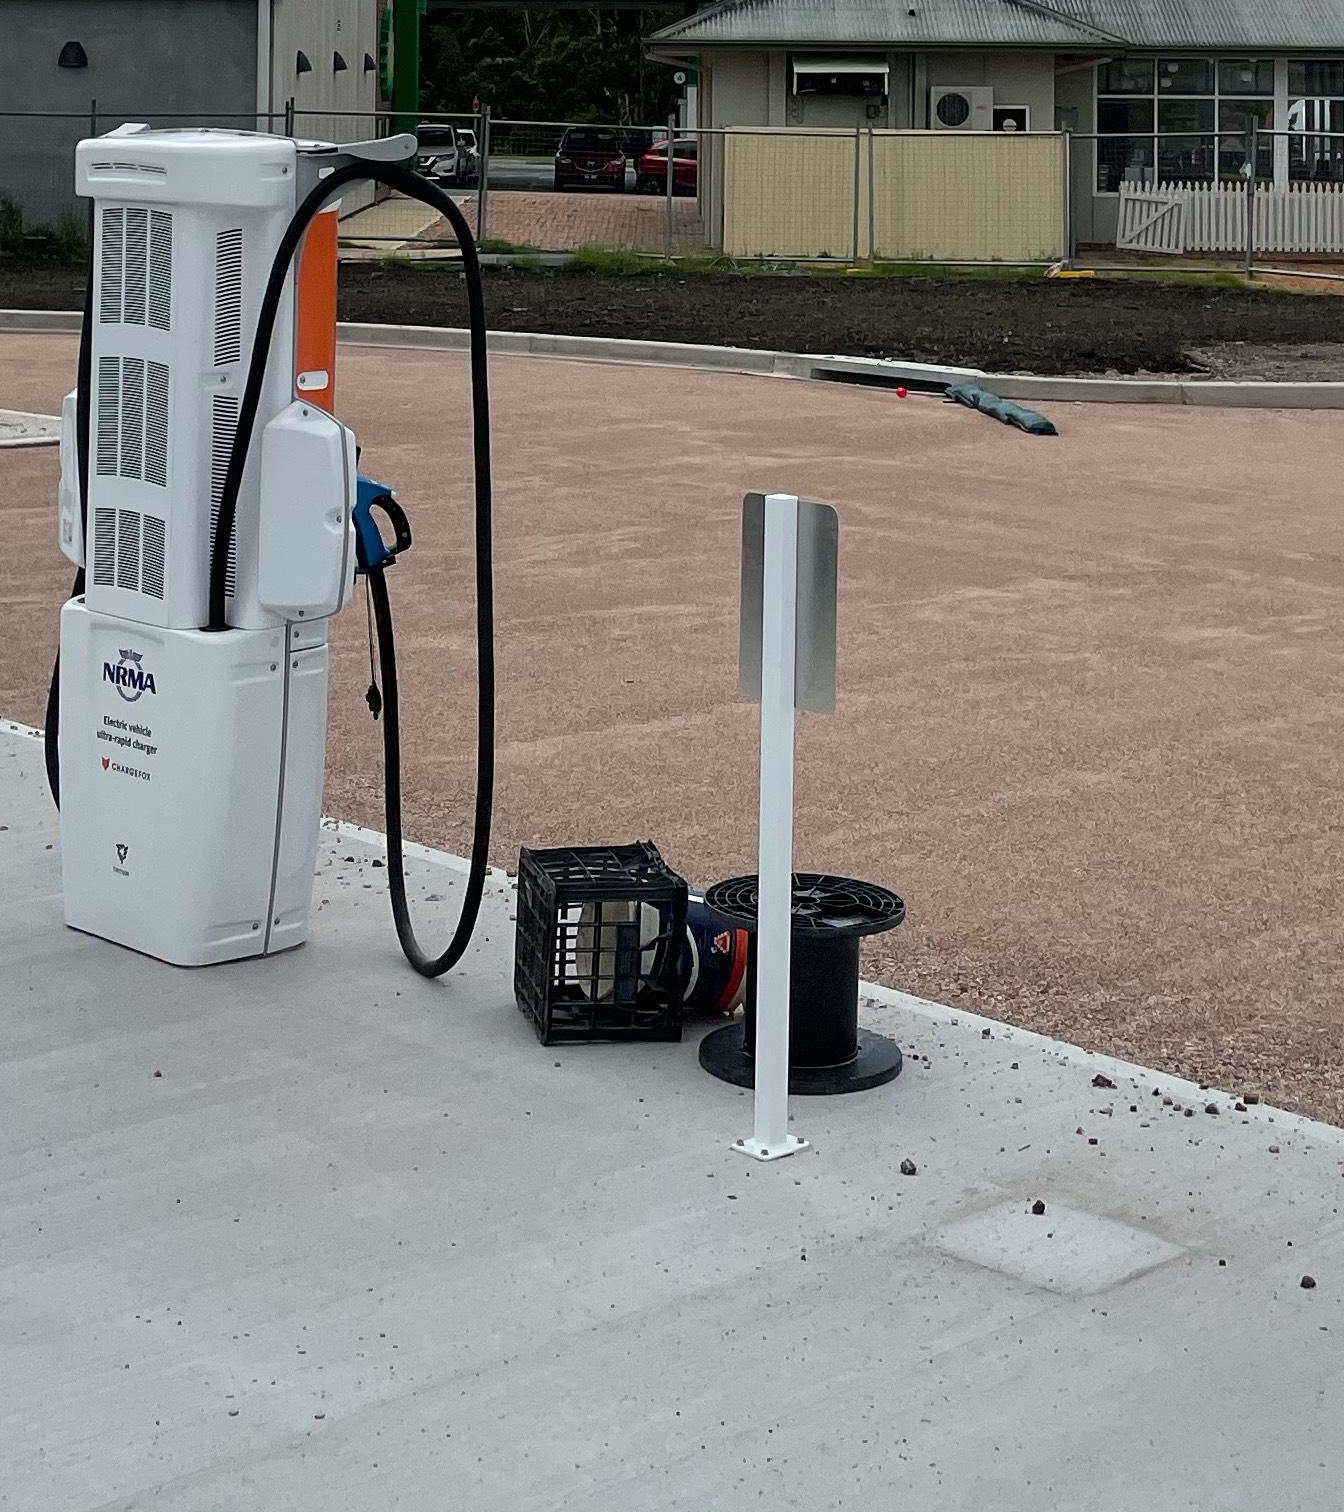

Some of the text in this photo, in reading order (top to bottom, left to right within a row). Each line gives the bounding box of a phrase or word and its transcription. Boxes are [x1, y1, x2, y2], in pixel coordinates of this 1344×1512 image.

[103, 662, 157, 695] NRMA
[103, 715, 152, 738] Electric vehicle
[132, 739, 158, 755] charger
[111, 762, 151, 781] CHARGEFOX
